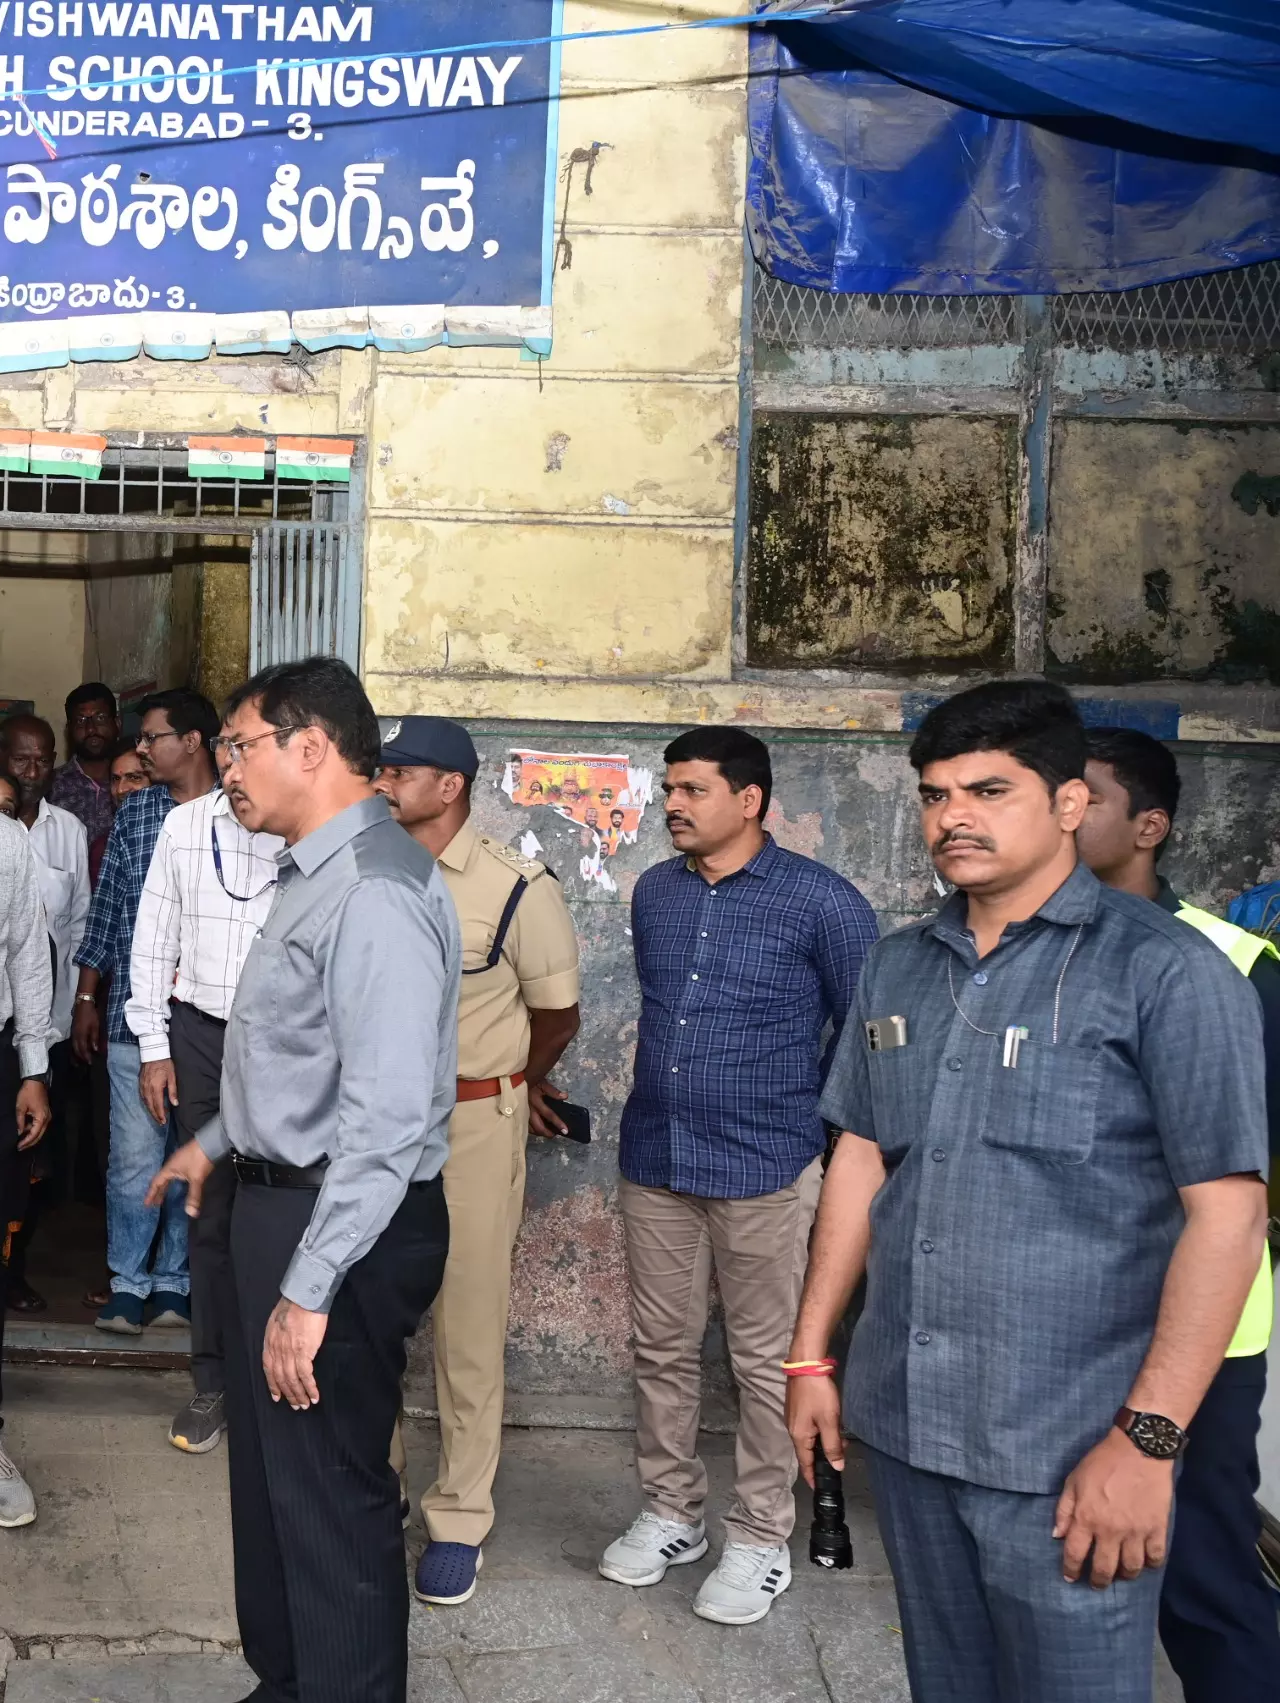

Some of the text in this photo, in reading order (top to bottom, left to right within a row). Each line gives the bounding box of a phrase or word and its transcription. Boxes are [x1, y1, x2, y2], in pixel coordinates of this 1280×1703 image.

[46, 55, 234, 104] SCHOOL
[256, 56, 523, 108] KINGSWAY
[4, 163, 249, 260] పాఠశాల,
